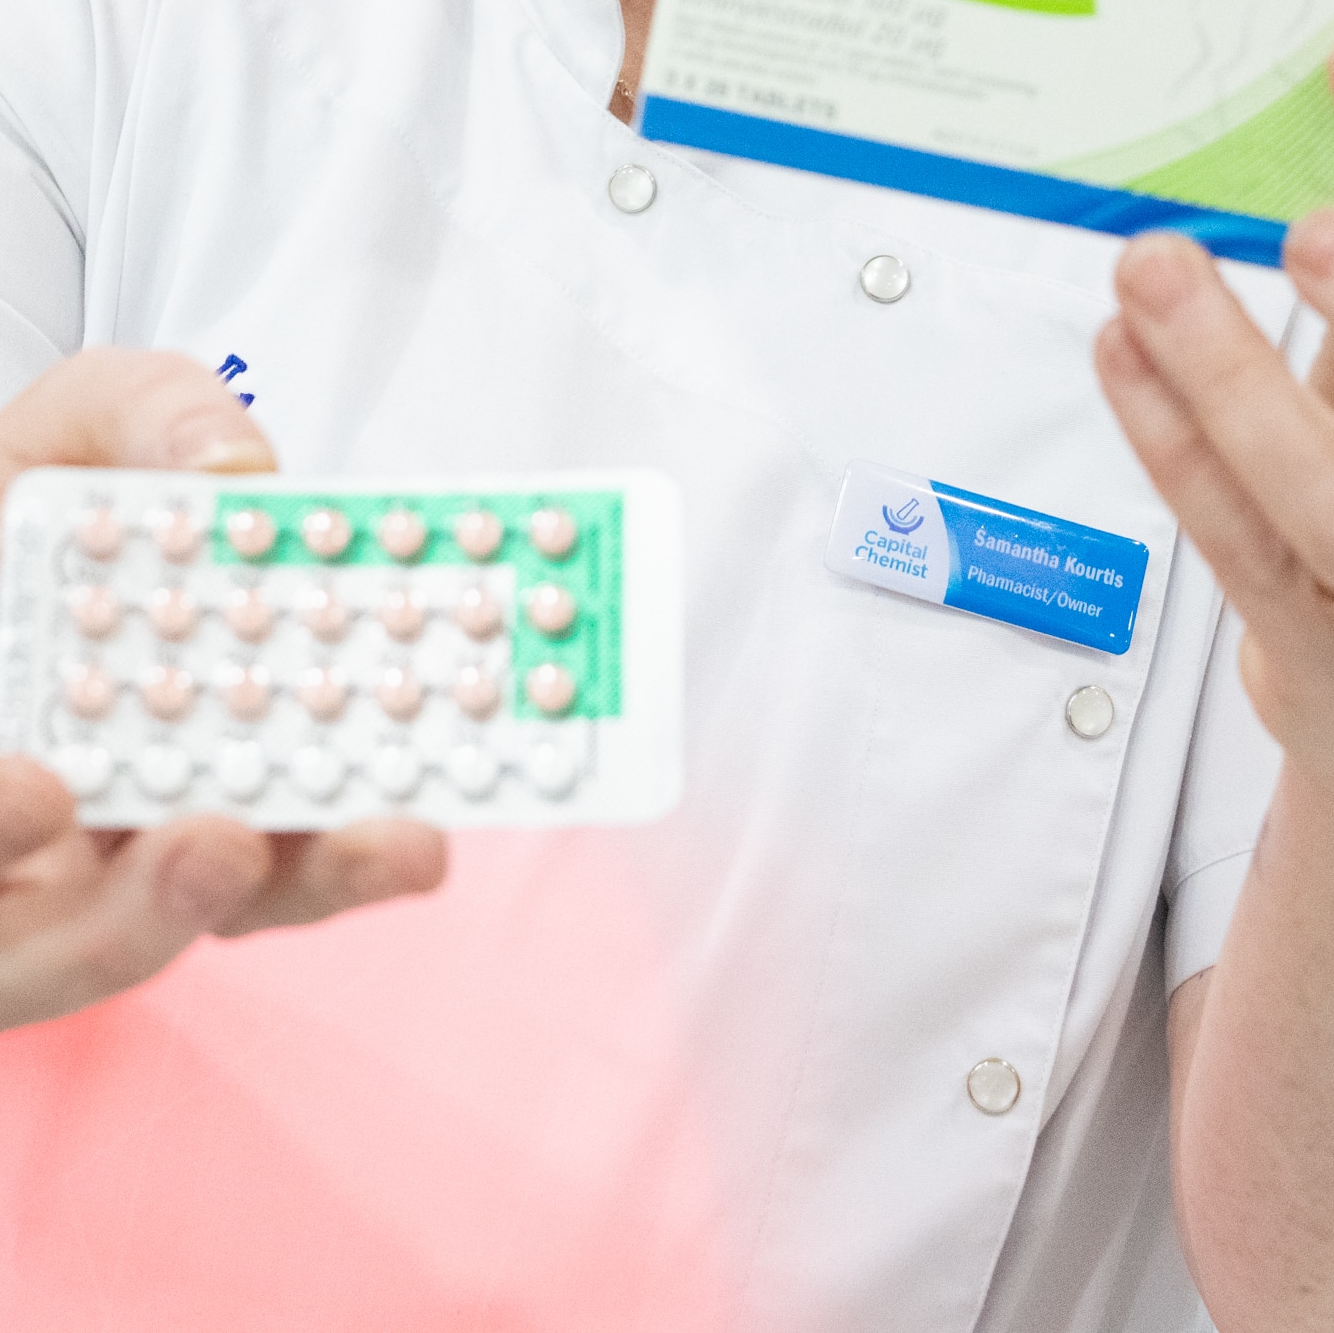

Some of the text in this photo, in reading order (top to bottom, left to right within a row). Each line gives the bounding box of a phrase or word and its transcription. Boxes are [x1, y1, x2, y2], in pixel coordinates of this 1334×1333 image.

[855, 545, 929, 579] Chemist
[864, 530, 928, 561] Capital
[974, 528, 1124, 589] Samantha Kourtis
[967, 565, 1103, 618] Pharmacist/Owner
